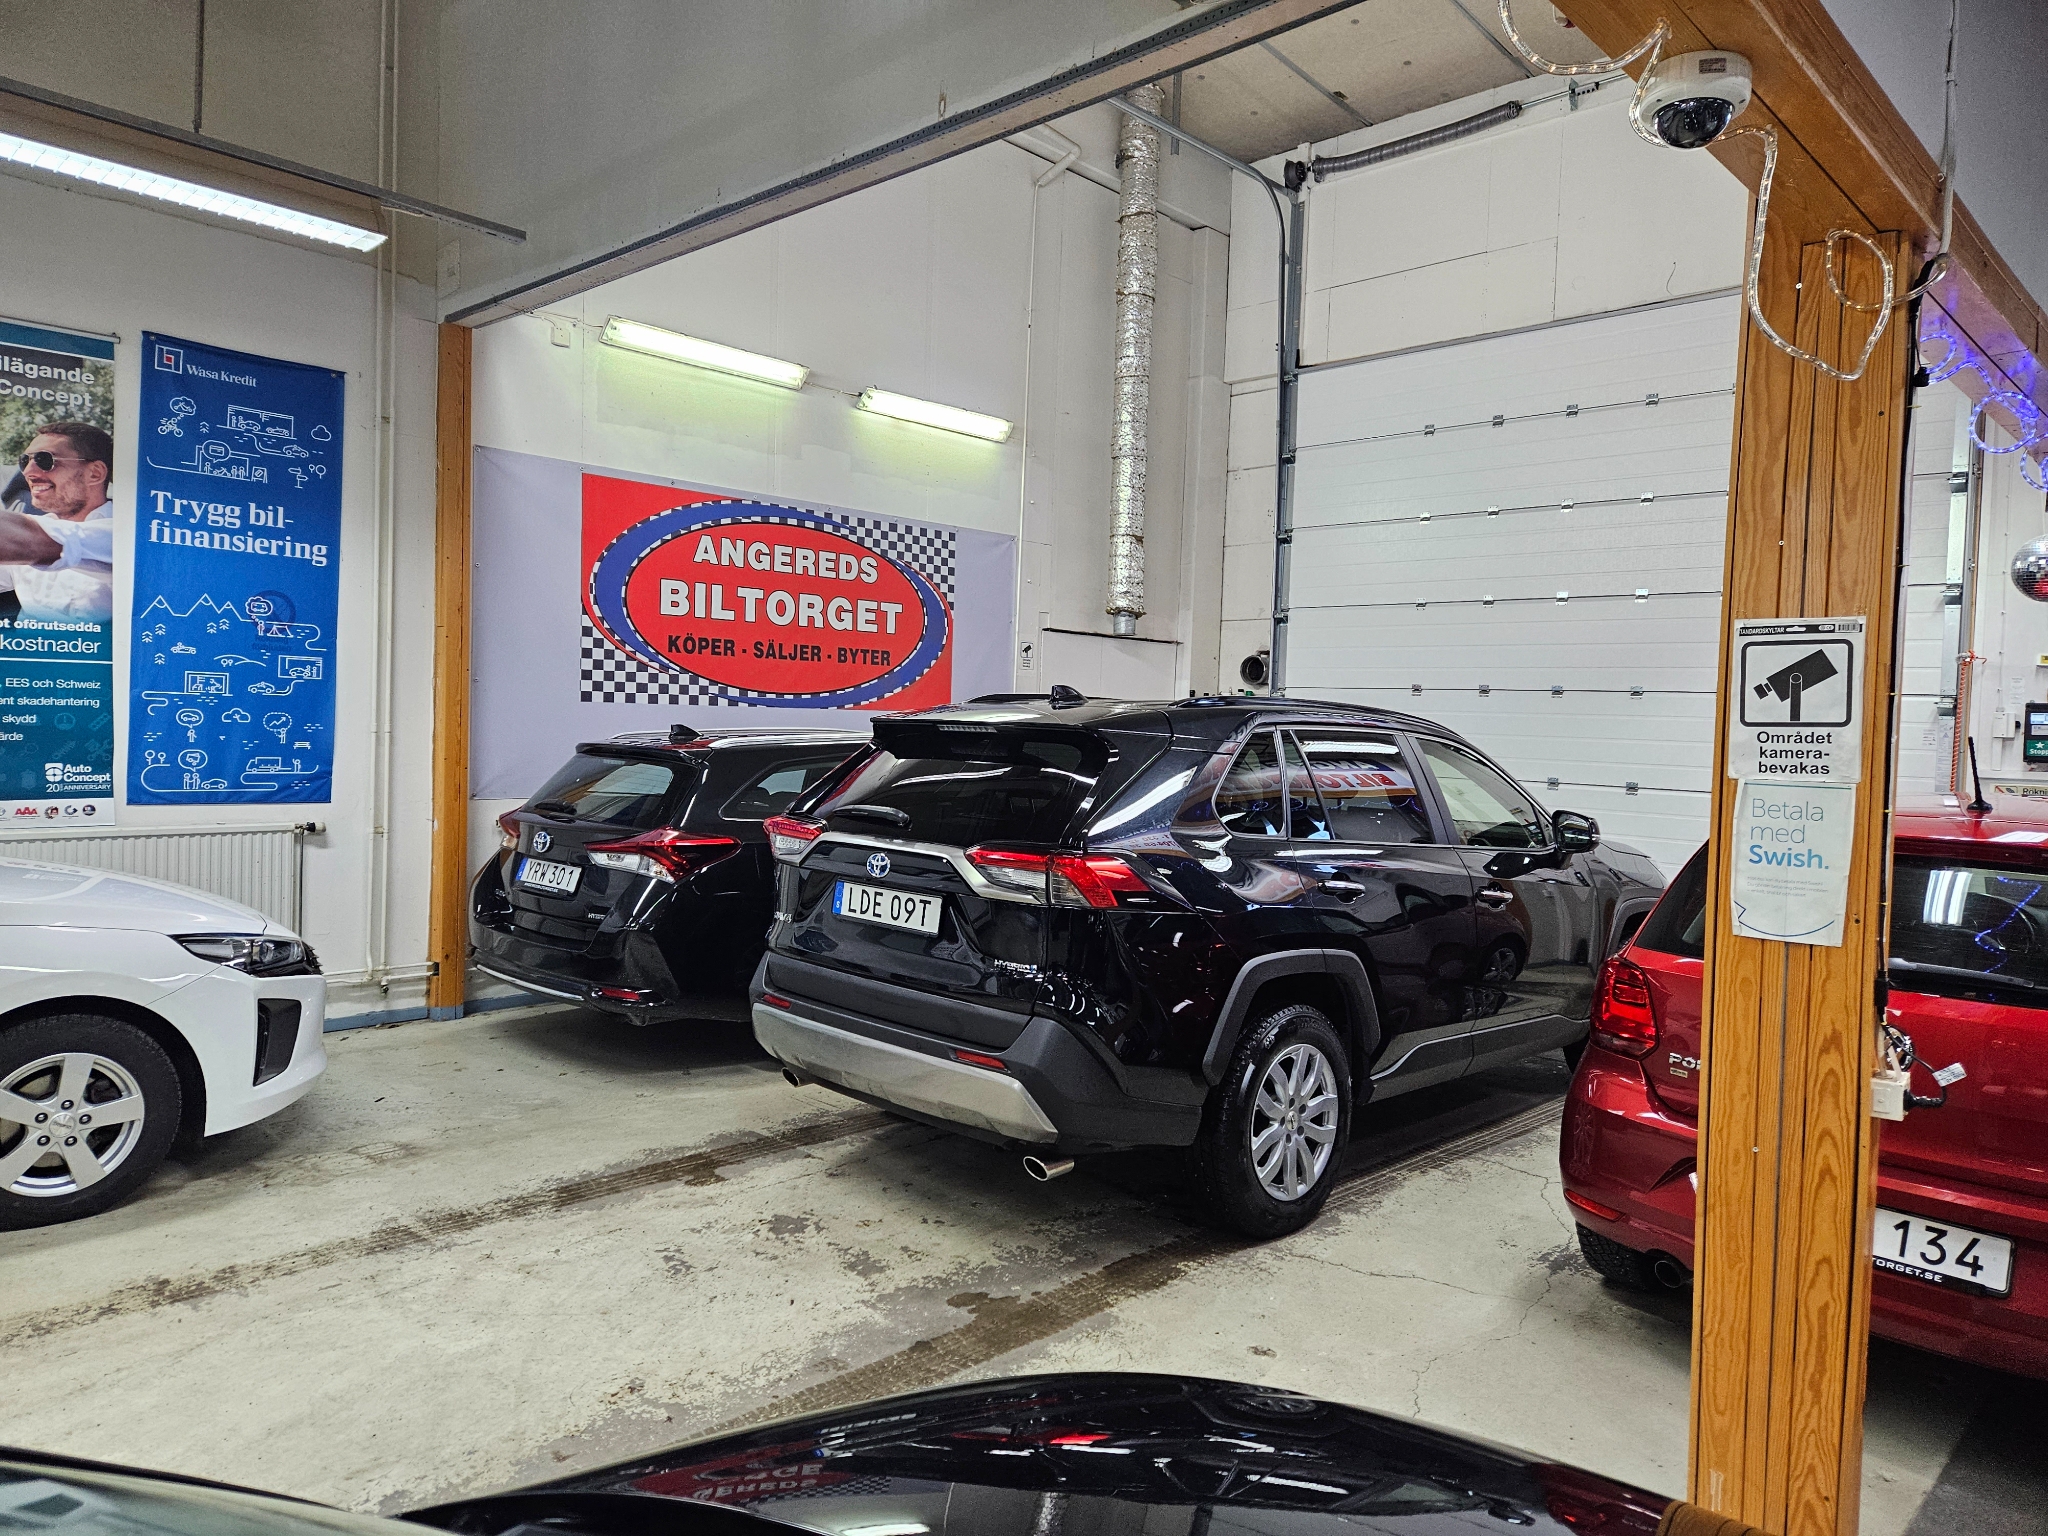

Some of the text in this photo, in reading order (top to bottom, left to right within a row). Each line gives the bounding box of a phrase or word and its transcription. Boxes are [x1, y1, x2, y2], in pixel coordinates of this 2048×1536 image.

[0, 355, 95, 385] lägande
[186, 363, 257, 387] Wasa Kredit
[0, 378, 92, 408] Concept
[150, 489, 294, 529] Trygg bil-
[148, 519, 328, 567] finansiering
[693, 534, 879, 584] ANGEREDS
[660, 578, 903, 635] BILTORGET
[13, 619, 102, 633] oförutsedda
[0, 634, 102, 653] kostnader
[667, 632, 736, 657] KÖPER
[753, 639, 822, 662] SÄLJER
[837, 646, 891, 667] BYTER
[5, 678, 102, 690] EES och Schweiz
[17, 697, 100, 708] skadehantering
[2, 714, 37, 725] skydd
[1756, 730, 1833, 744] Området
[1759, 746, 1830, 759] kamera-
[64, 764, 92, 773] Auto
[64, 773, 111, 783] Concept
[1758, 761, 1830, 774] bevakas
[46, 784, 60, 792] 20
[1752, 798, 1824, 822] Betala
[1750, 824, 1806, 844] med
[1749, 844, 1830, 870] Swish.
[526, 861, 550, 882] YRW
[548, 865, 575, 888] 301
[848, 887, 932, 927] LDE 09T
[1893, 1219, 1984, 1278] 134
